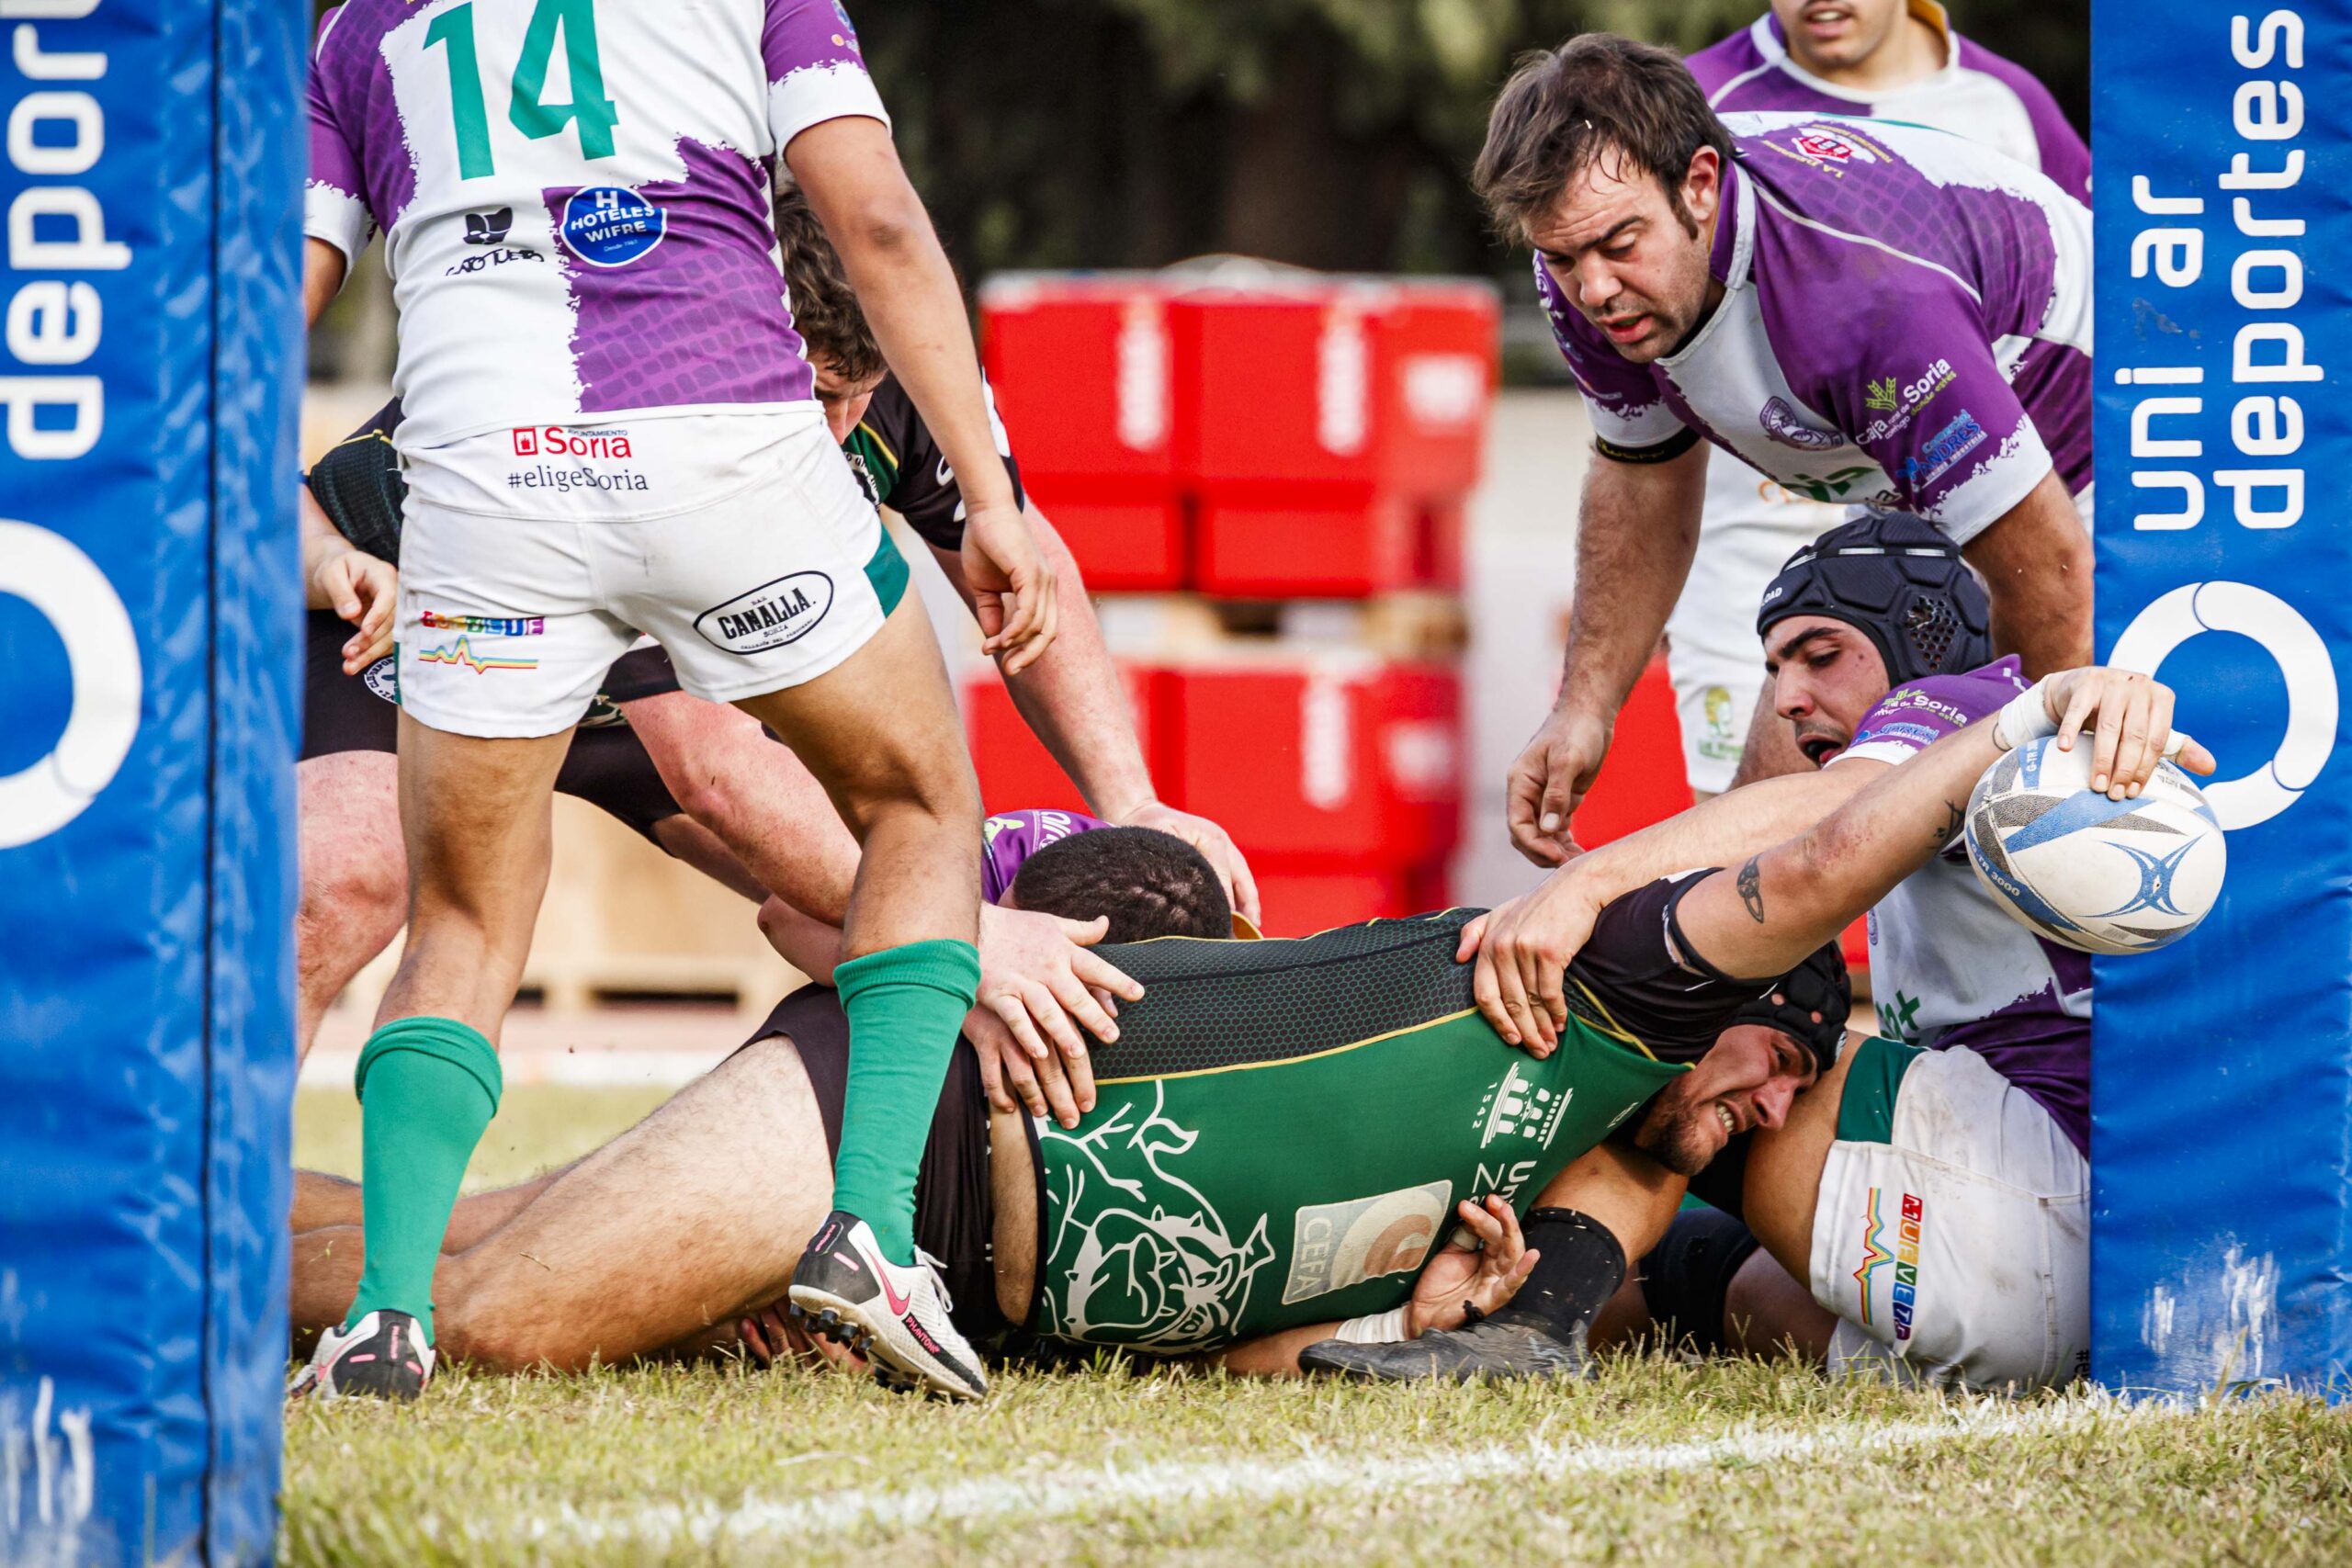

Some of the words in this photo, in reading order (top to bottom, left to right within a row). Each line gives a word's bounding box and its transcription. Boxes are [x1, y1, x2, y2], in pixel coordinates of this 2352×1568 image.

[423, 0, 619, 180] 14
[595, 191, 618, 209] H
[571, 206, 655, 231] HOTELES
[584, 220, 647, 243] WIFRE
[2212, 8, 2324, 530] deportes
[1903, 358, 1951, 403] Soria
[1900, 403, 1910, 413] de
[544, 425, 632, 458] Soria
[1855, 419, 1888, 446] Caja
[508, 465, 649, 492] #eligeSoria
[1914, 695, 1968, 725] Soria
[1991, 871, 2020, 897] 3000
[1472, 1082, 1498, 1129] 1542
[1292, 1217, 1332, 1296] CEFA
